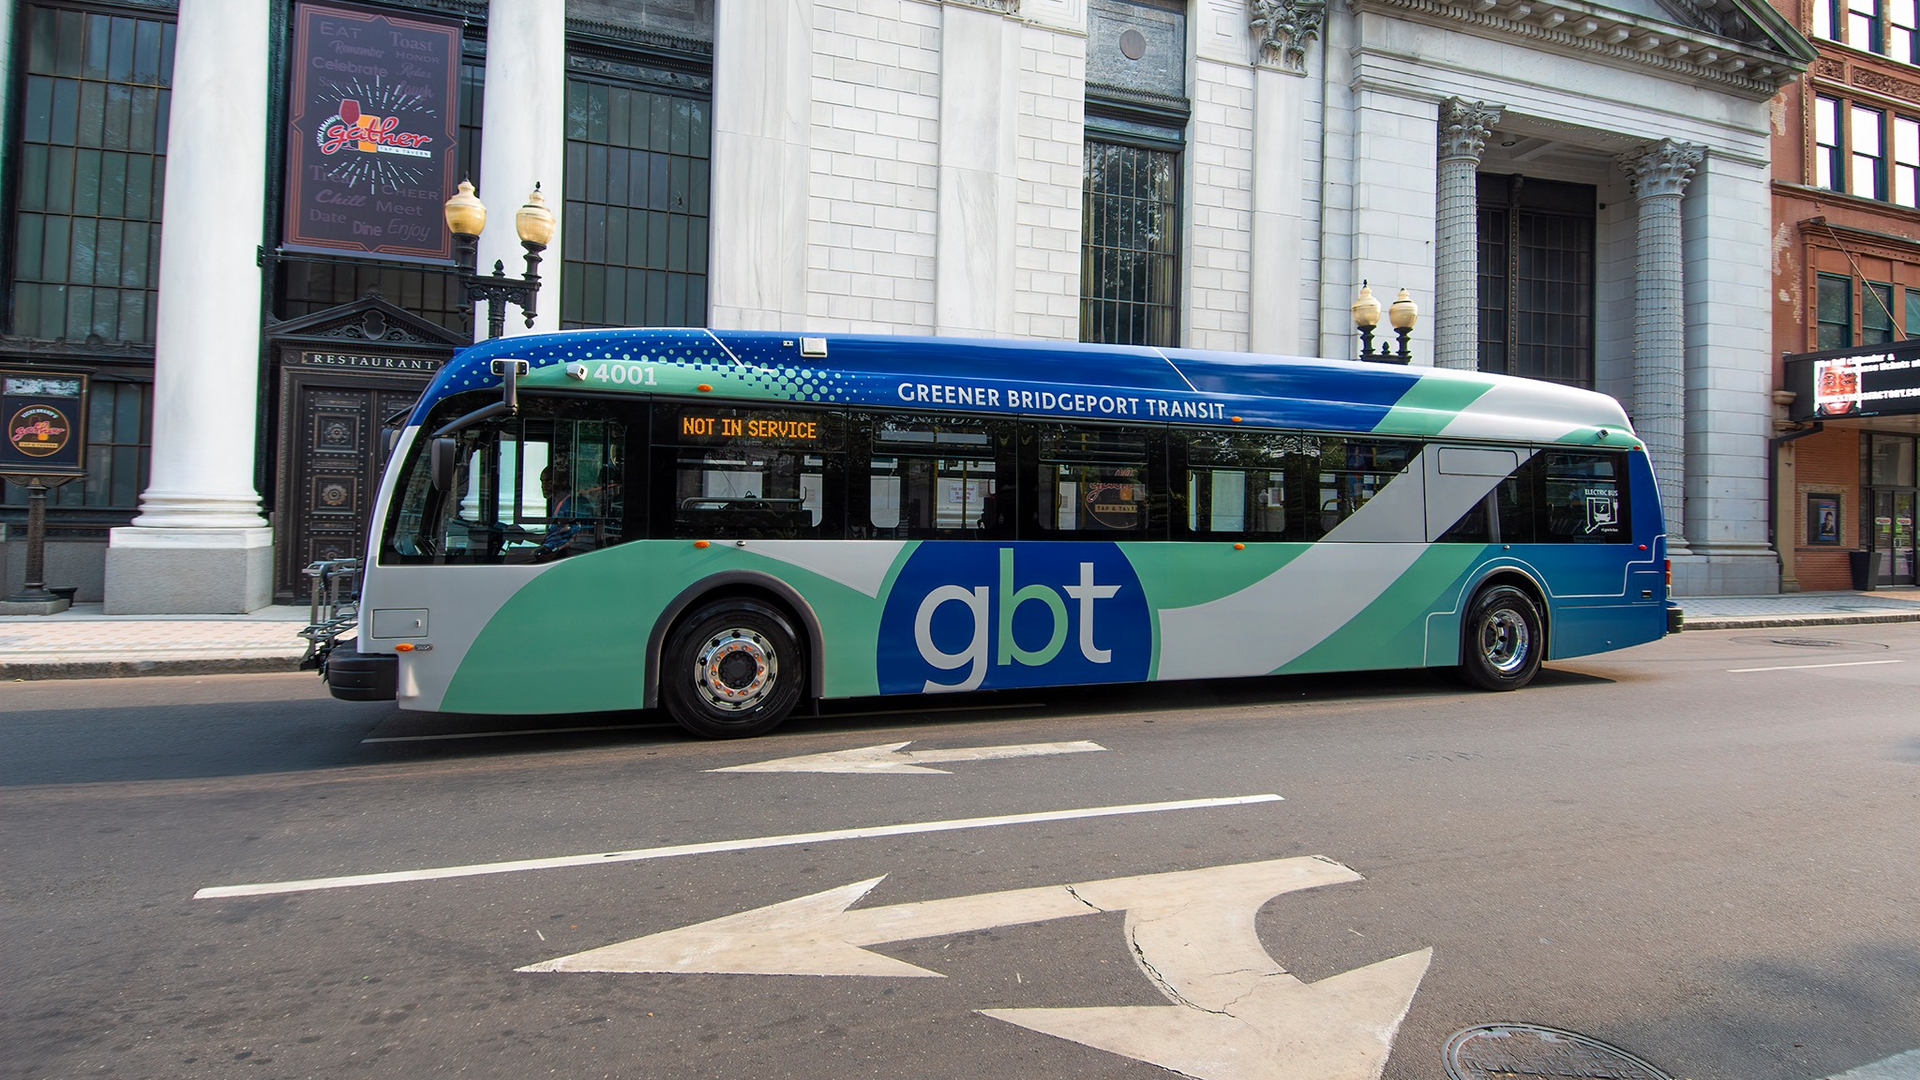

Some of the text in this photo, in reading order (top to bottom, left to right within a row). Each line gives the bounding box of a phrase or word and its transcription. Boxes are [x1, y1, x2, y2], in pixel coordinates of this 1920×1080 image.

[320, 21, 362, 39] EAT
[328, 40, 385, 59] Remember
[389, 31, 434, 52] Toast
[312, 56, 389, 77] Celebrate
[395, 50, 440, 64] HONOR
[396, 62, 433, 79] Relax
[397, 80, 435, 104] Laugh
[321, 116, 433, 155] gather
[315, 189, 367, 207] Chill
[381, 184, 439, 201] CHEER
[309, 209, 347, 224] Date
[375, 200, 423, 216] Meet
[353, 221, 383, 237] Dine
[388, 219, 431, 241] Enjoy
[313, 354, 434, 370] RESTAURANT
[594, 363, 657, 387] 4001
[897, 382, 1225, 420] GREENER BRIDGEPORT TRANSIT
[683, 417, 817, 439] NOT IN SERVICE
[914, 547, 1122, 694] gbt
